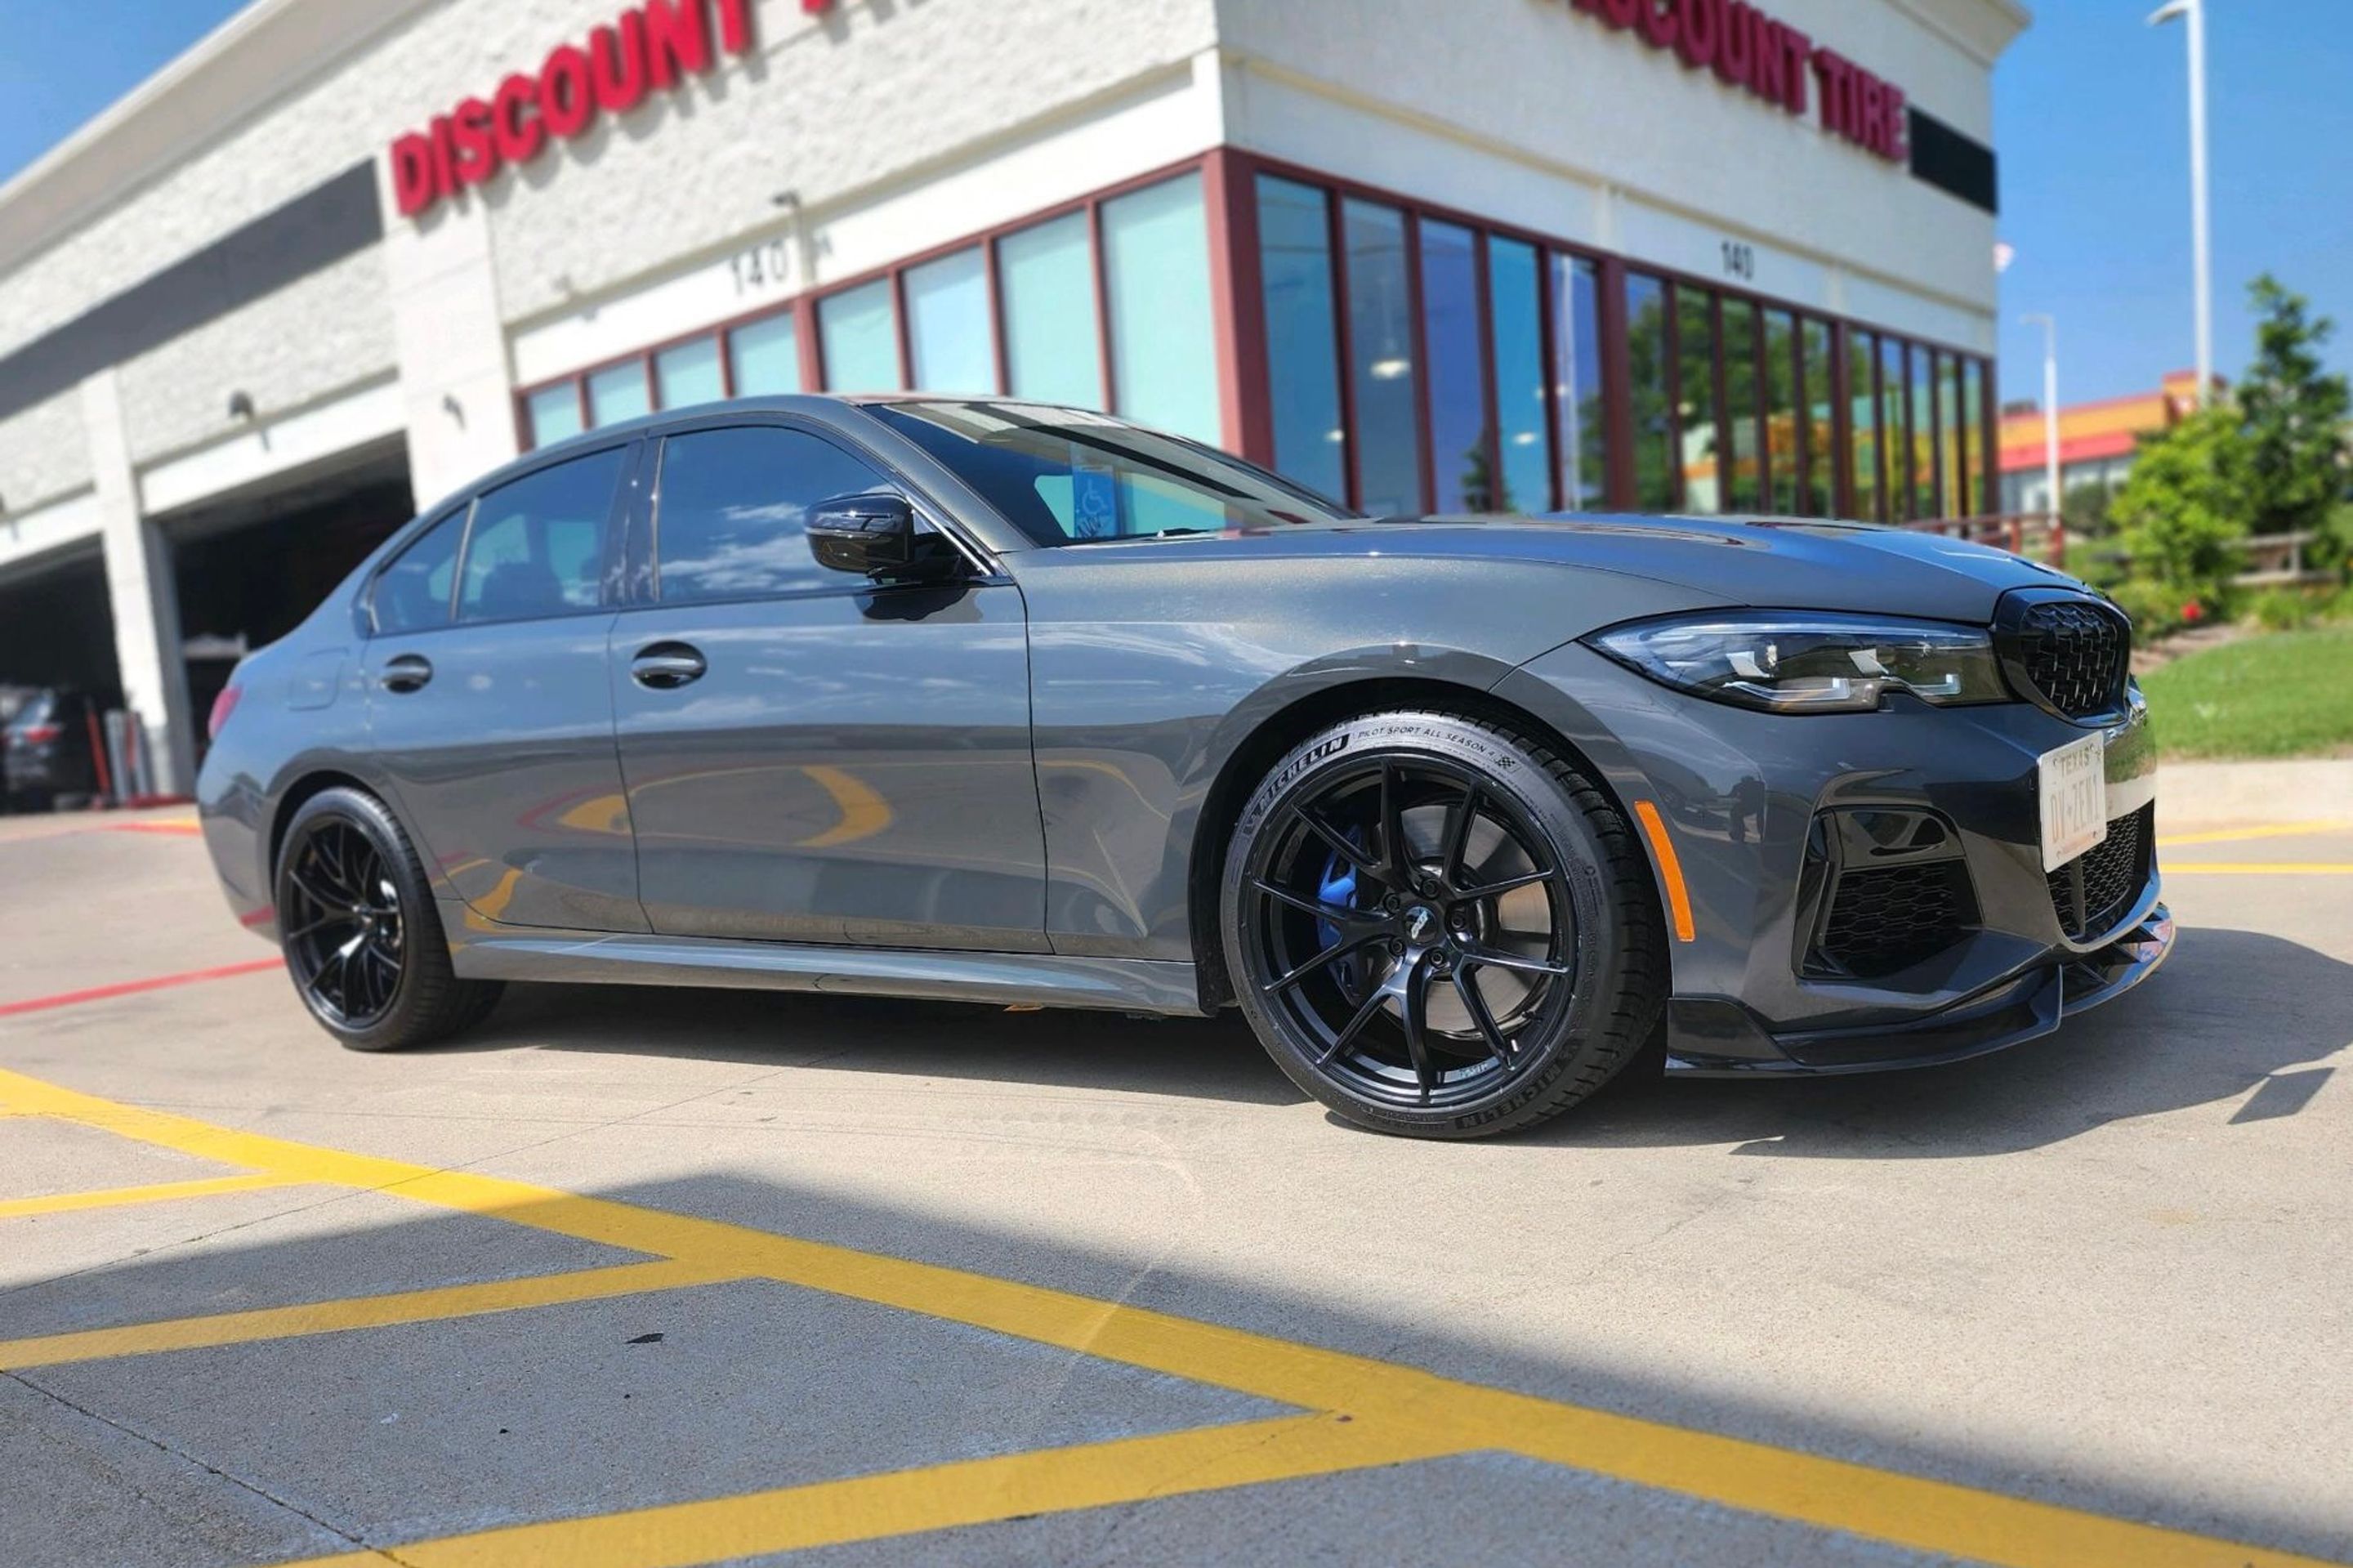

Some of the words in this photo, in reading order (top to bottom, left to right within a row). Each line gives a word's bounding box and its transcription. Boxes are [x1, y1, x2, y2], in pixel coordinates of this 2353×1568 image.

[1812, 46, 1909, 161] TIRE
[731, 239, 789, 296] 140
[1721, 241, 1755, 280] 140
[1357, 727, 1384, 739] PILOT
[1387, 726, 1419, 735] SPORT
[1423, 728, 1440, 738] ALL
[1445, 733, 1486, 753] SEASON
[2061, 746, 2090, 777] TEXAS
[1258, 737, 1342, 811] MICHELIN
[1462, 1063, 1561, 1129] MICHELIN
